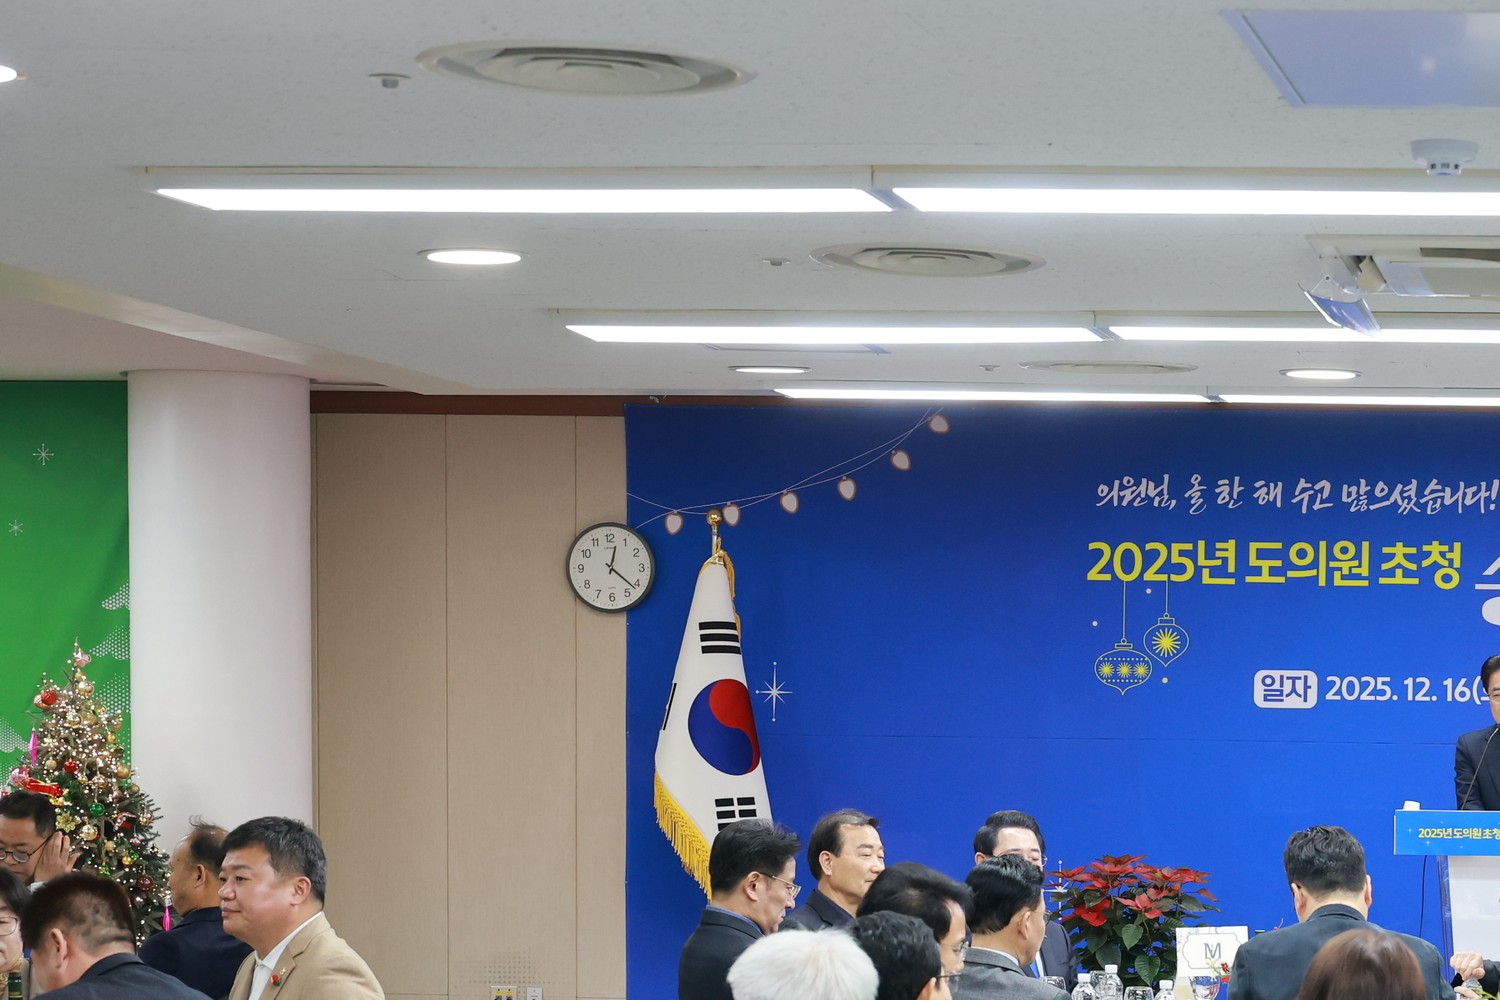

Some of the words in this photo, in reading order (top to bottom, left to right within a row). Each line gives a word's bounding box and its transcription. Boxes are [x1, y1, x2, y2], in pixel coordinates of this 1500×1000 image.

[1095, 473, 1177, 511] 의원님,
[1184, 473, 1207, 515] 올
[1214, 475, 1245, 509] 한
[1252, 475, 1283, 508] 해
[1291, 477, 1334, 514] 수고
[1341, 478, 1500, 515] 많으셨습니다!
[591, 538, 599, 547] 11
[604, 533, 615, 543] 12
[623, 538, 627, 547] 1
[581, 548, 591, 558] 10
[633, 548, 640, 557] 2
[577, 564, 584, 573] 9
[638, 563, 645, 572] 3
[1086, 539, 1236, 585] 2025년
[1245, 540, 1370, 587] 도의원
[1378, 540, 1462, 590] 초청
[584, 579, 591, 589] 8
[634, 579, 640, 587] 4
[595, 589, 601, 598] 7
[609, 592, 616, 602] 6
[624, 588, 631, 597] 5
[1261, 674, 1312, 703] 일자
[1325, 675, 1398, 701] 2025.
[1403, 676, 1437, 702] 12.
[1443, 675, 1490, 705] 16(
[1418, 827, 1453, 840] 2025년
[1453, 827, 1482, 840] 도의원
